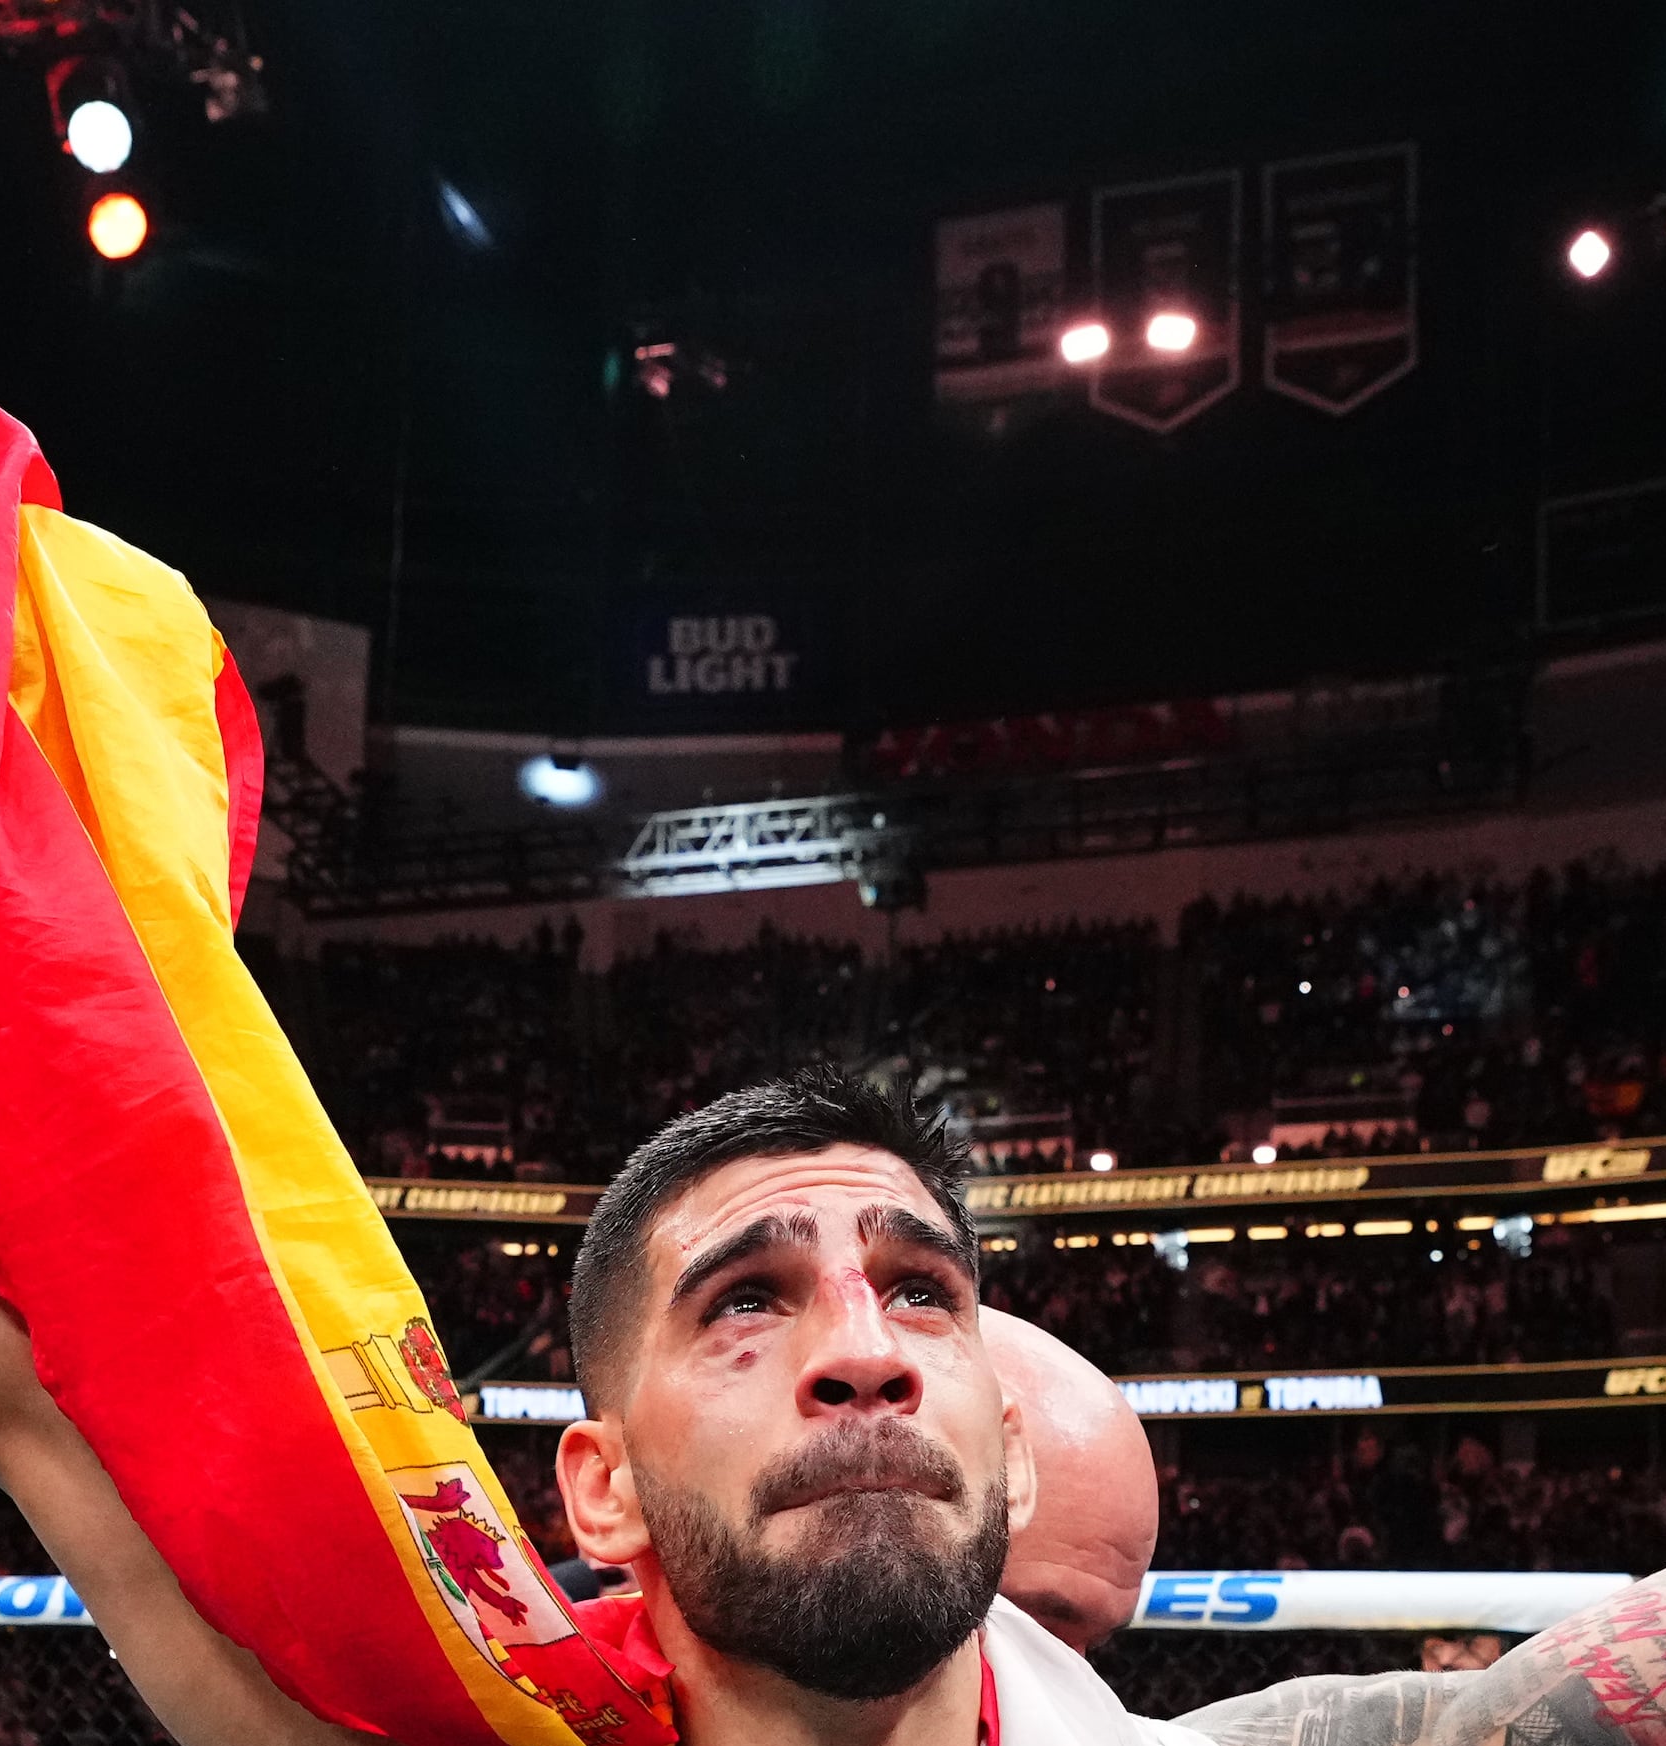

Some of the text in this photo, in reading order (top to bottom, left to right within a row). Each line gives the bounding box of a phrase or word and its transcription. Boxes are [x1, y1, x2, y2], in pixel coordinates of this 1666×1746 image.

[668, 615, 777, 652] BUD
[648, 650, 799, 692] LIGHT
[1264, 1375, 1383, 1411] TOPURIA
